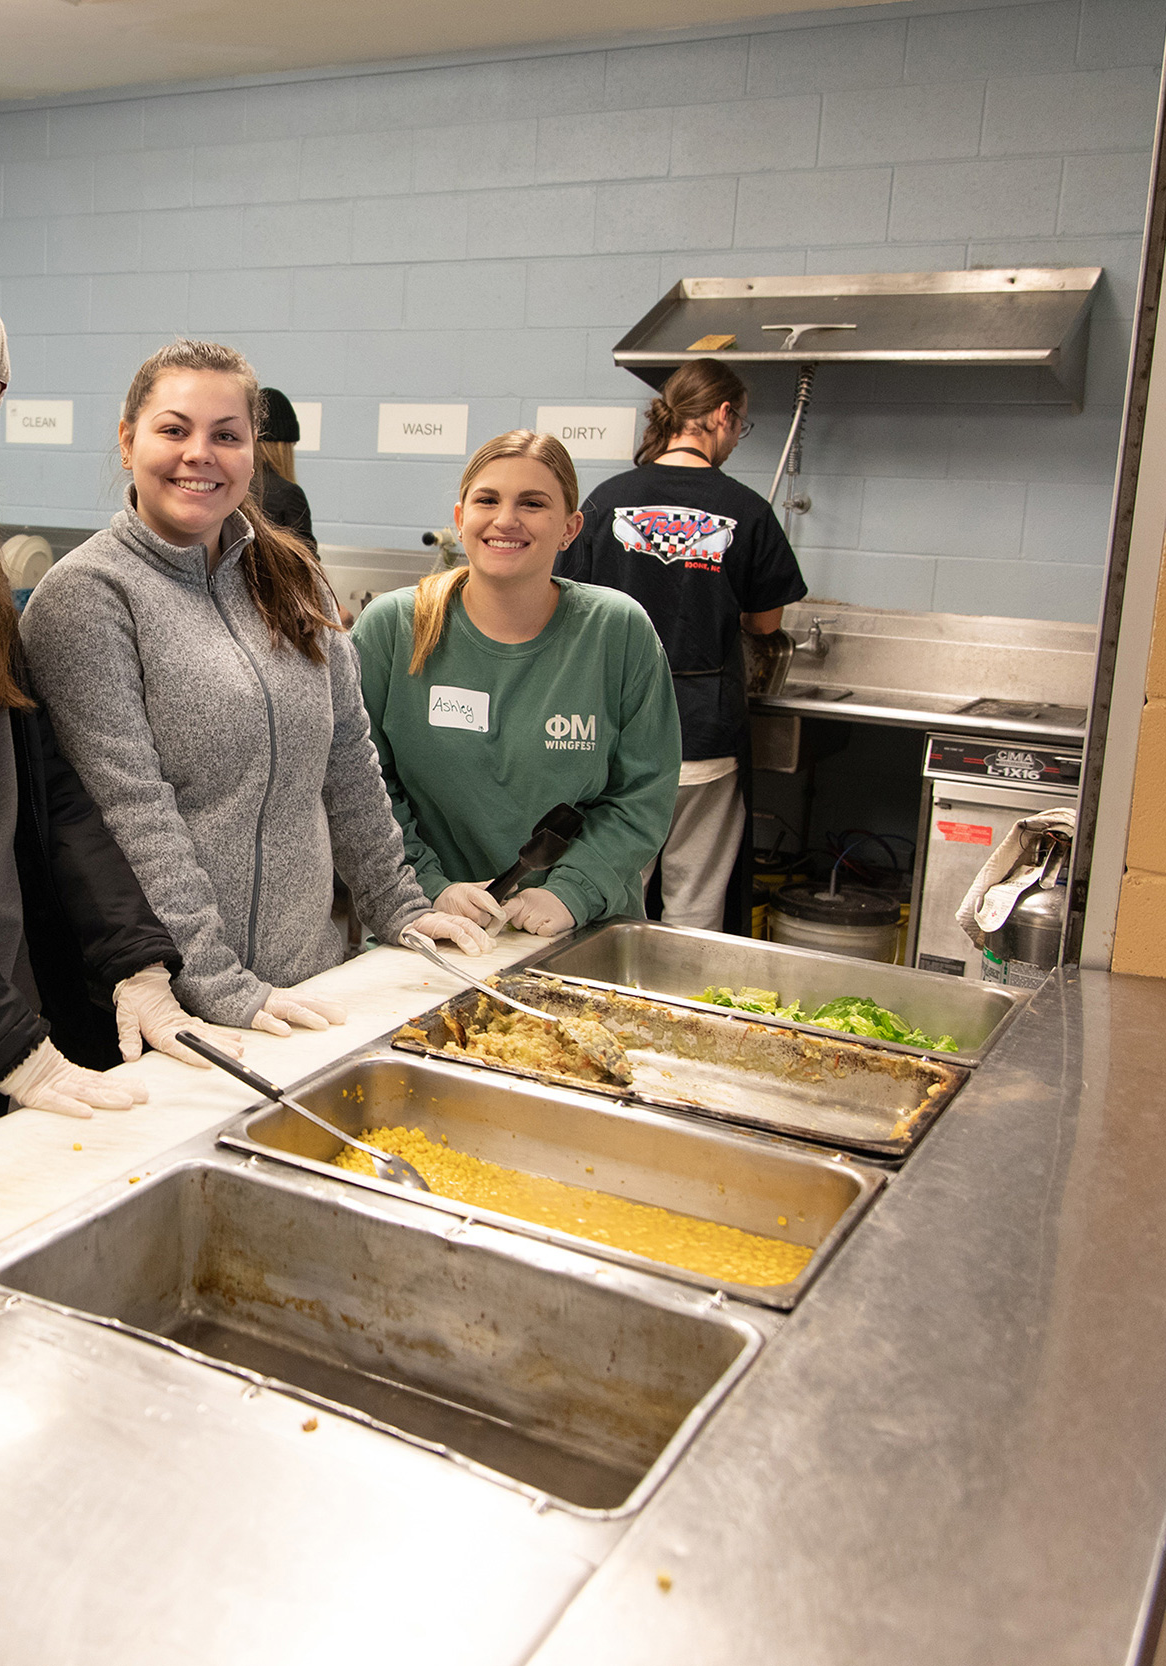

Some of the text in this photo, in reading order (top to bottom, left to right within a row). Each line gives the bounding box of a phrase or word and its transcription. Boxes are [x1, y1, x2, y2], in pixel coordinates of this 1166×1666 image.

[21, 416, 57, 428] CLEAN
[402, 423, 443, 436] WASH
[561, 426, 607, 440] DIRTY
[632, 510, 718, 541] Troy's
[710, 563, 721, 573] NC
[432, 697, 475, 724] Ashley
[544, 740, 596, 751] WINGFEST
[997, 750, 1035, 763] CMA
[987, 765, 1041, 780] L-1X16
